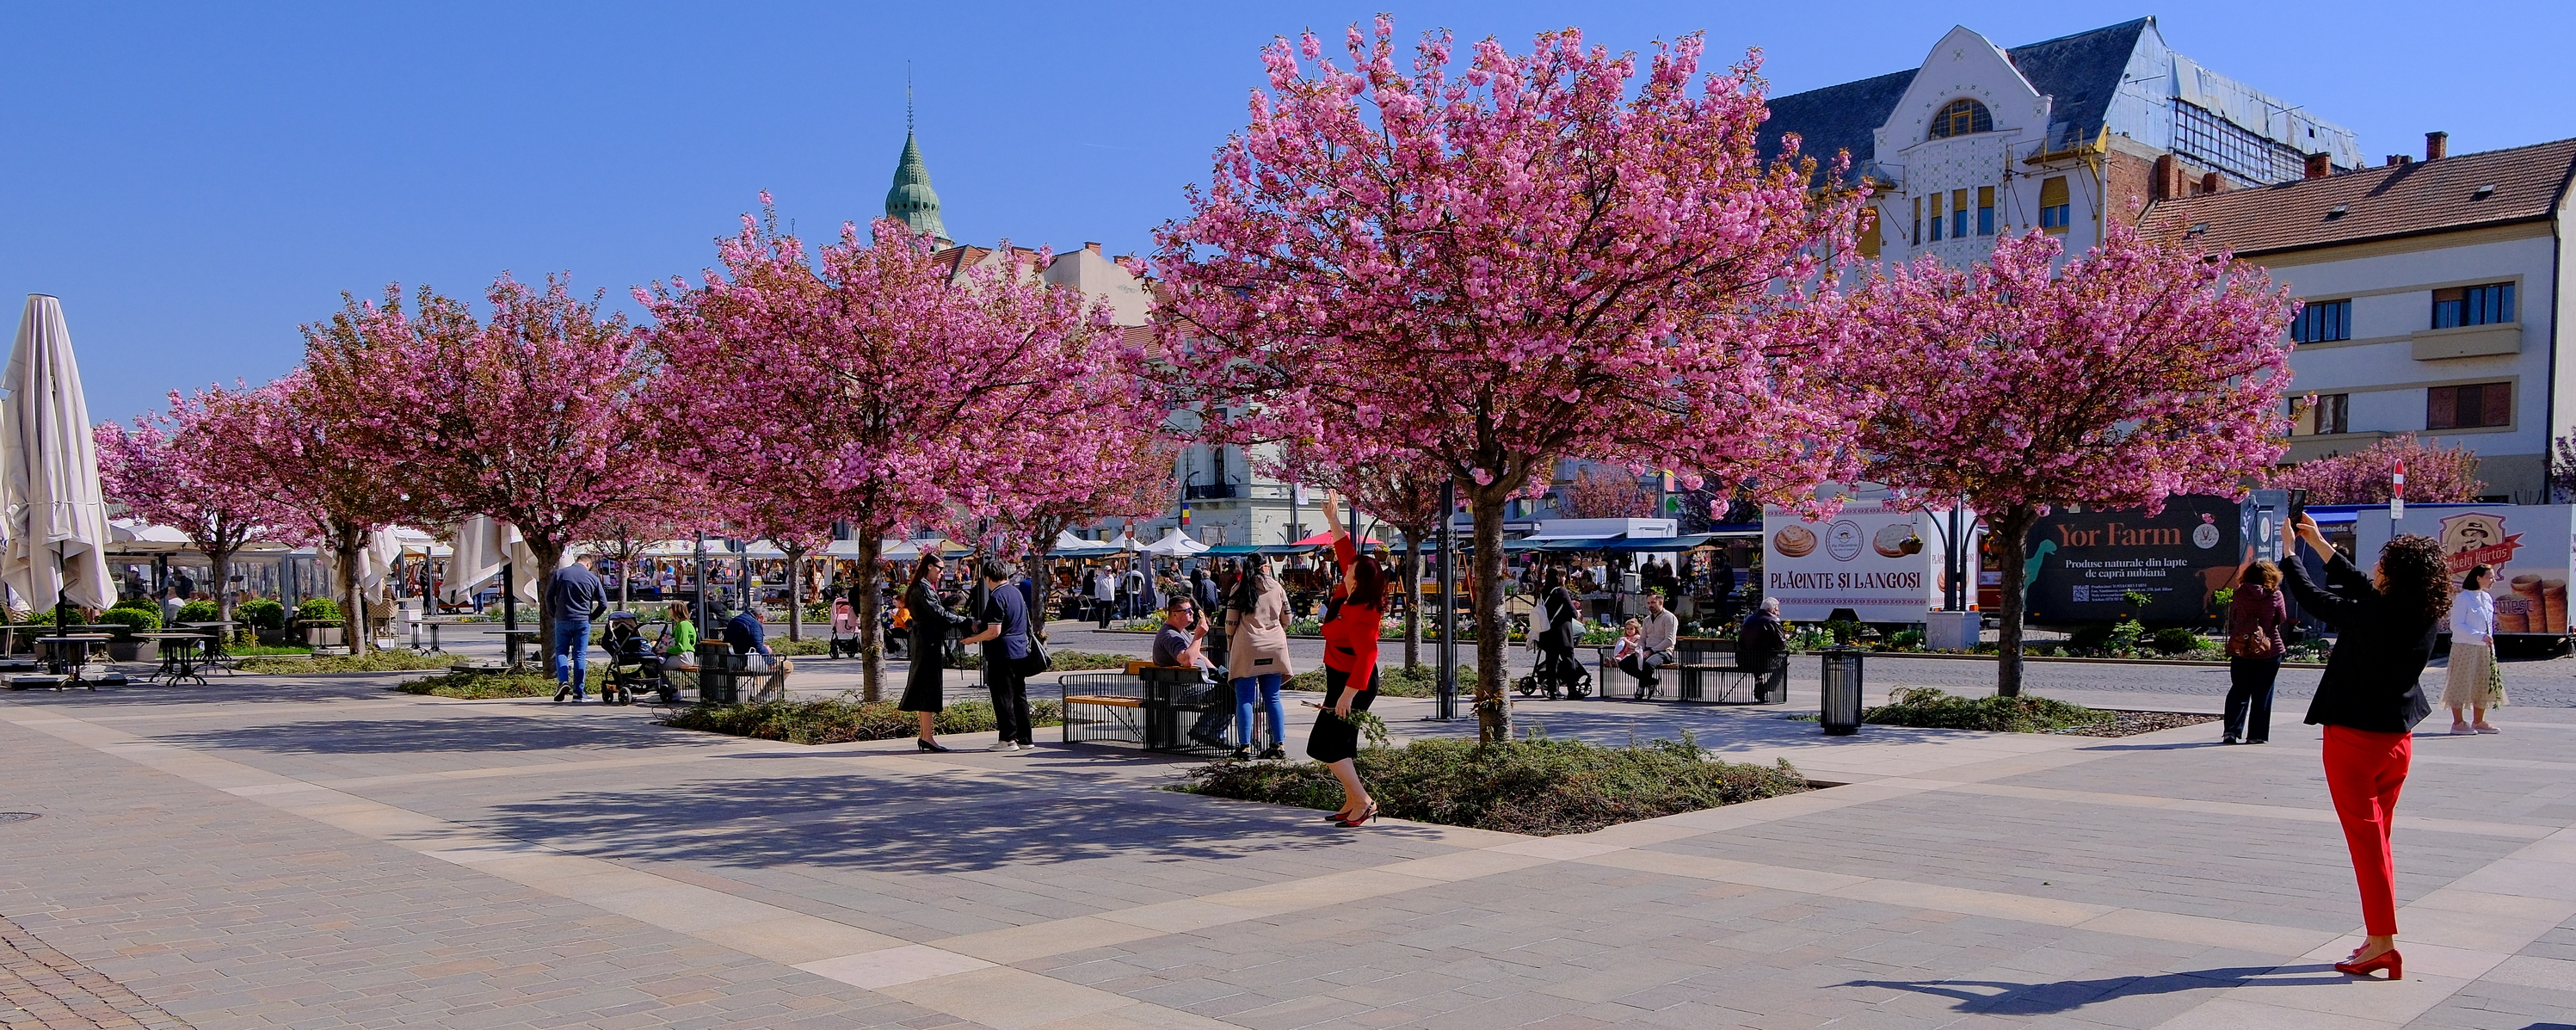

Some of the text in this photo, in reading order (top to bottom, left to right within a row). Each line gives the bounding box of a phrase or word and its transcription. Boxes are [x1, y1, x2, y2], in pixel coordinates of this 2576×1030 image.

[2056, 521, 2183, 547] Yor Farm
[2066, 558, 2188, 569] Produse naturale din lapte
[2452, 546, 2508, 570] kely Kürtös
[1770, 570, 1921, 592] PLĂCINTE ȘI LANGOȘI
[2085, 568, 2166, 579] de capră nubiană
